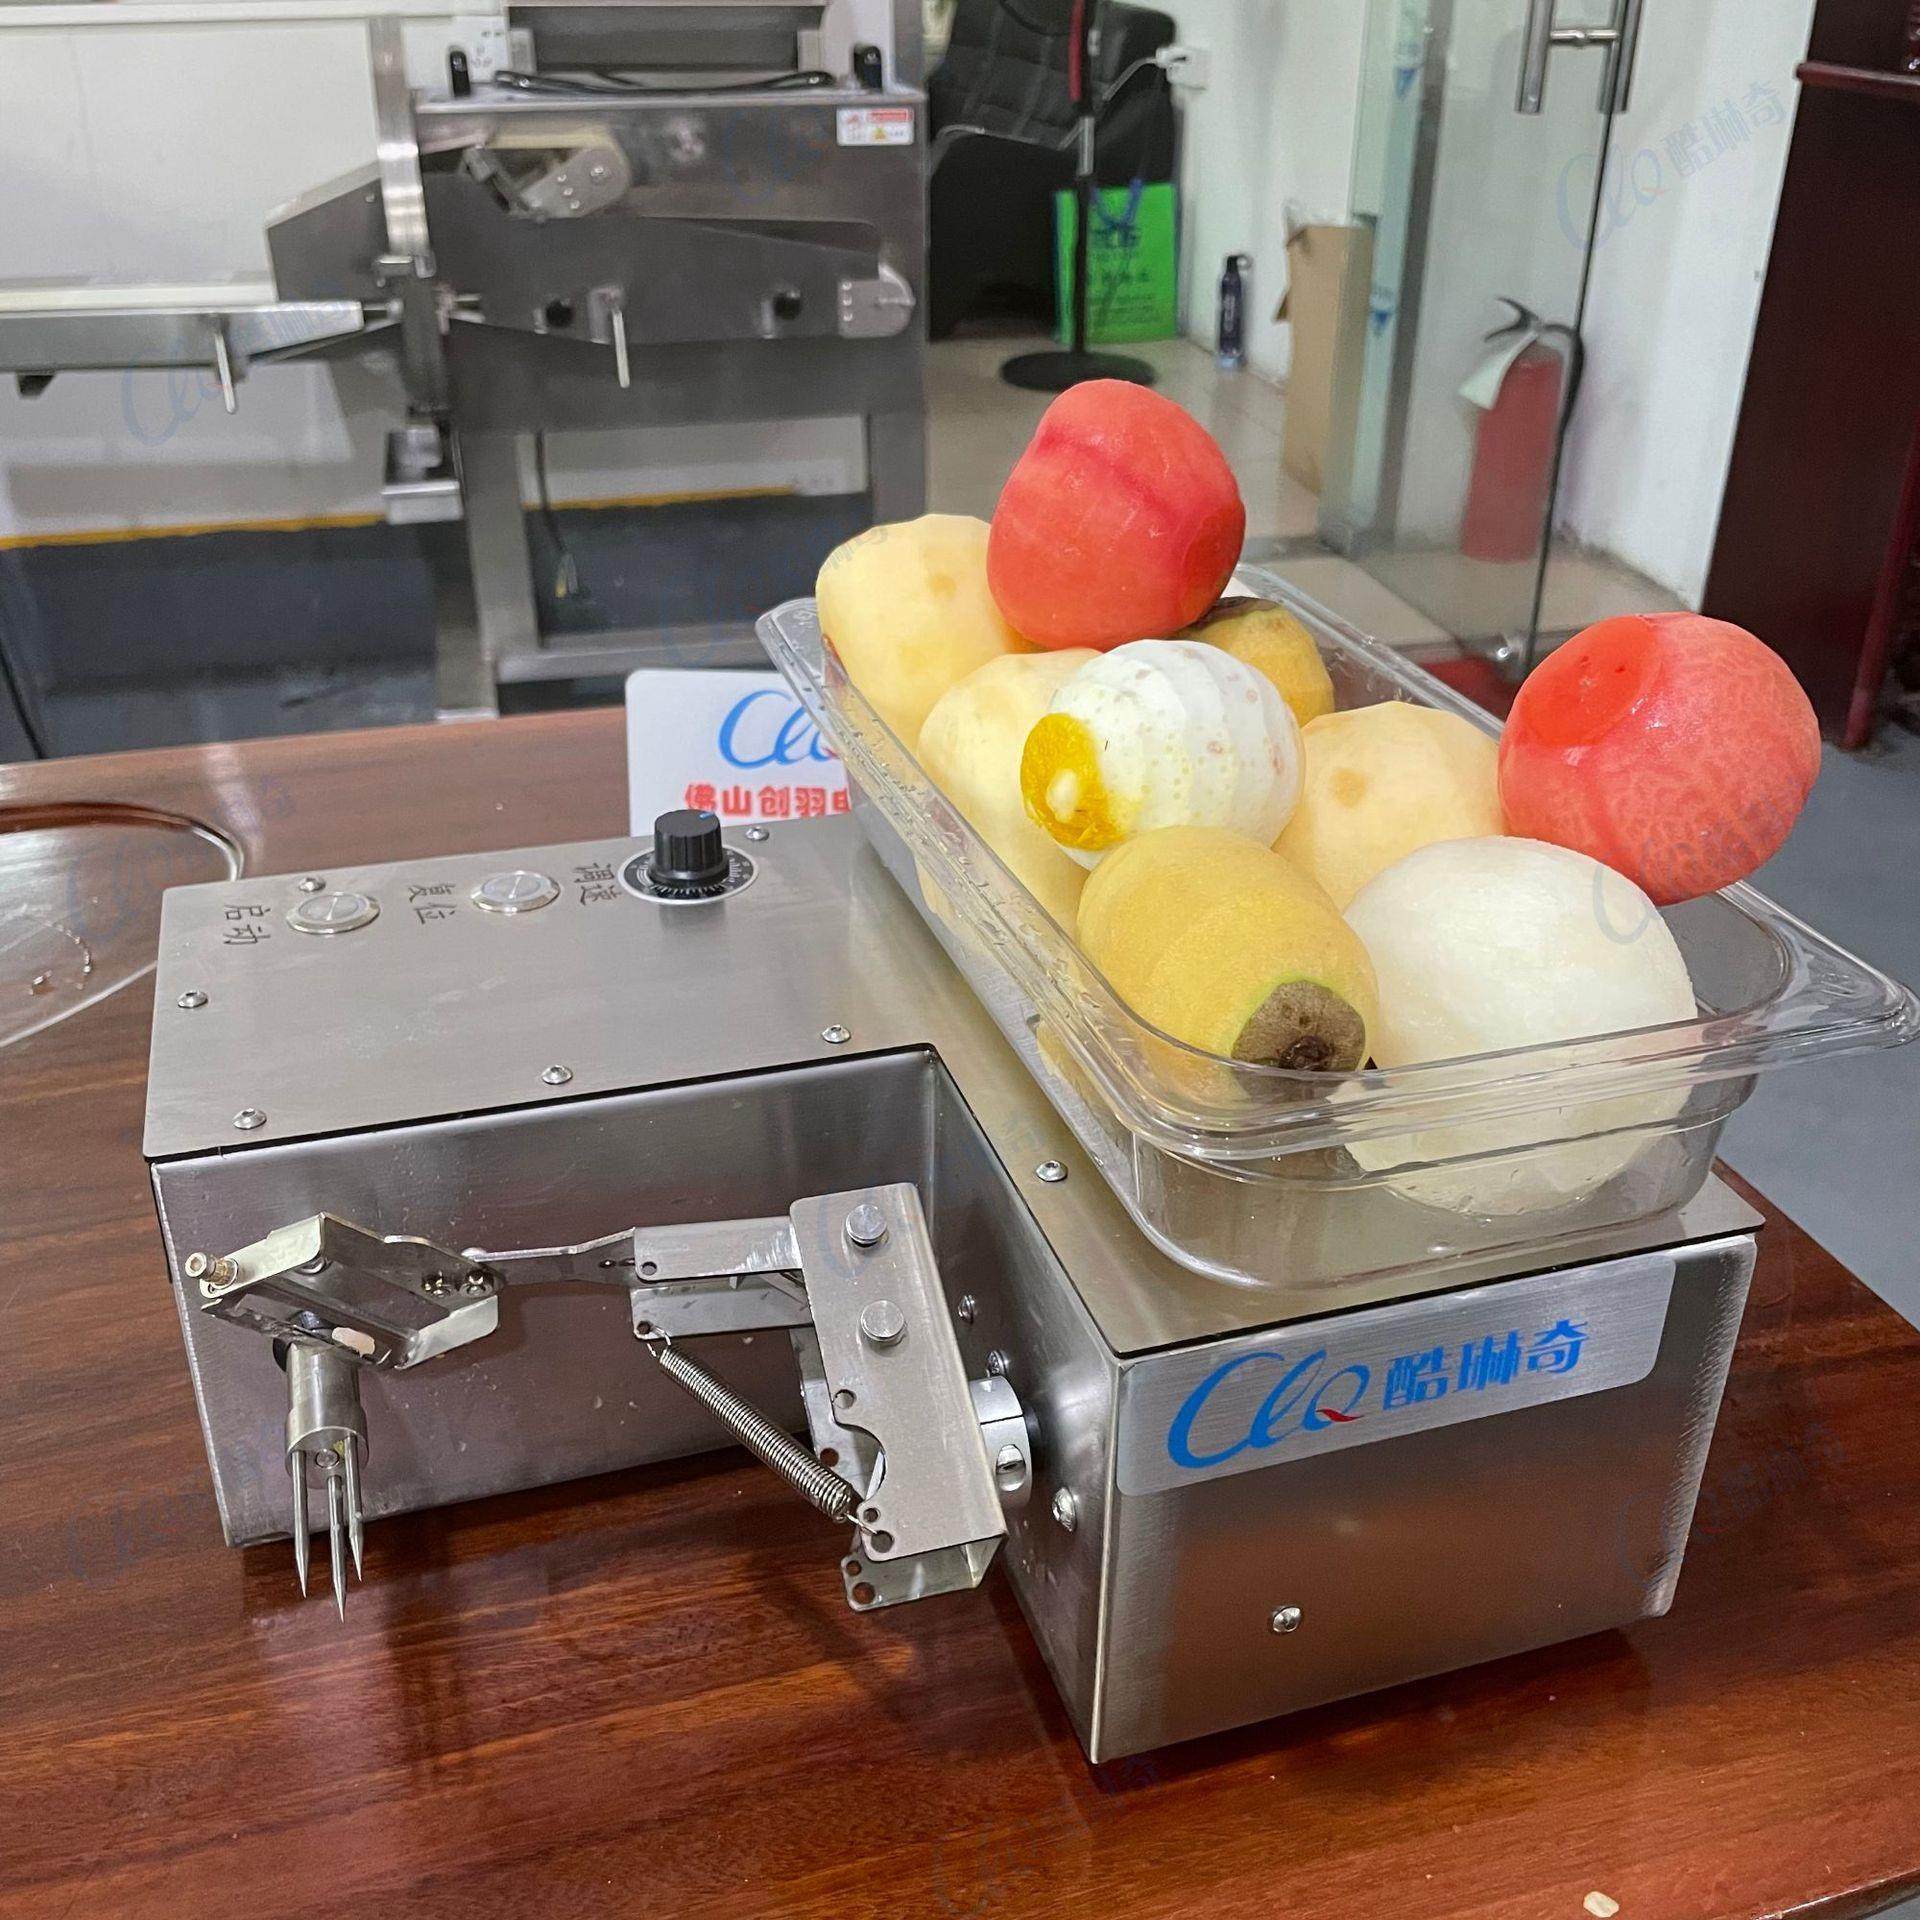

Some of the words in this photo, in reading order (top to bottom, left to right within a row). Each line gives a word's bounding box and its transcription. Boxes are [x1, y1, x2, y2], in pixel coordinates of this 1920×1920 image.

[223, 904, 271, 945] 启动
[1383, 1319, 1587, 1411] 酷琳奇
